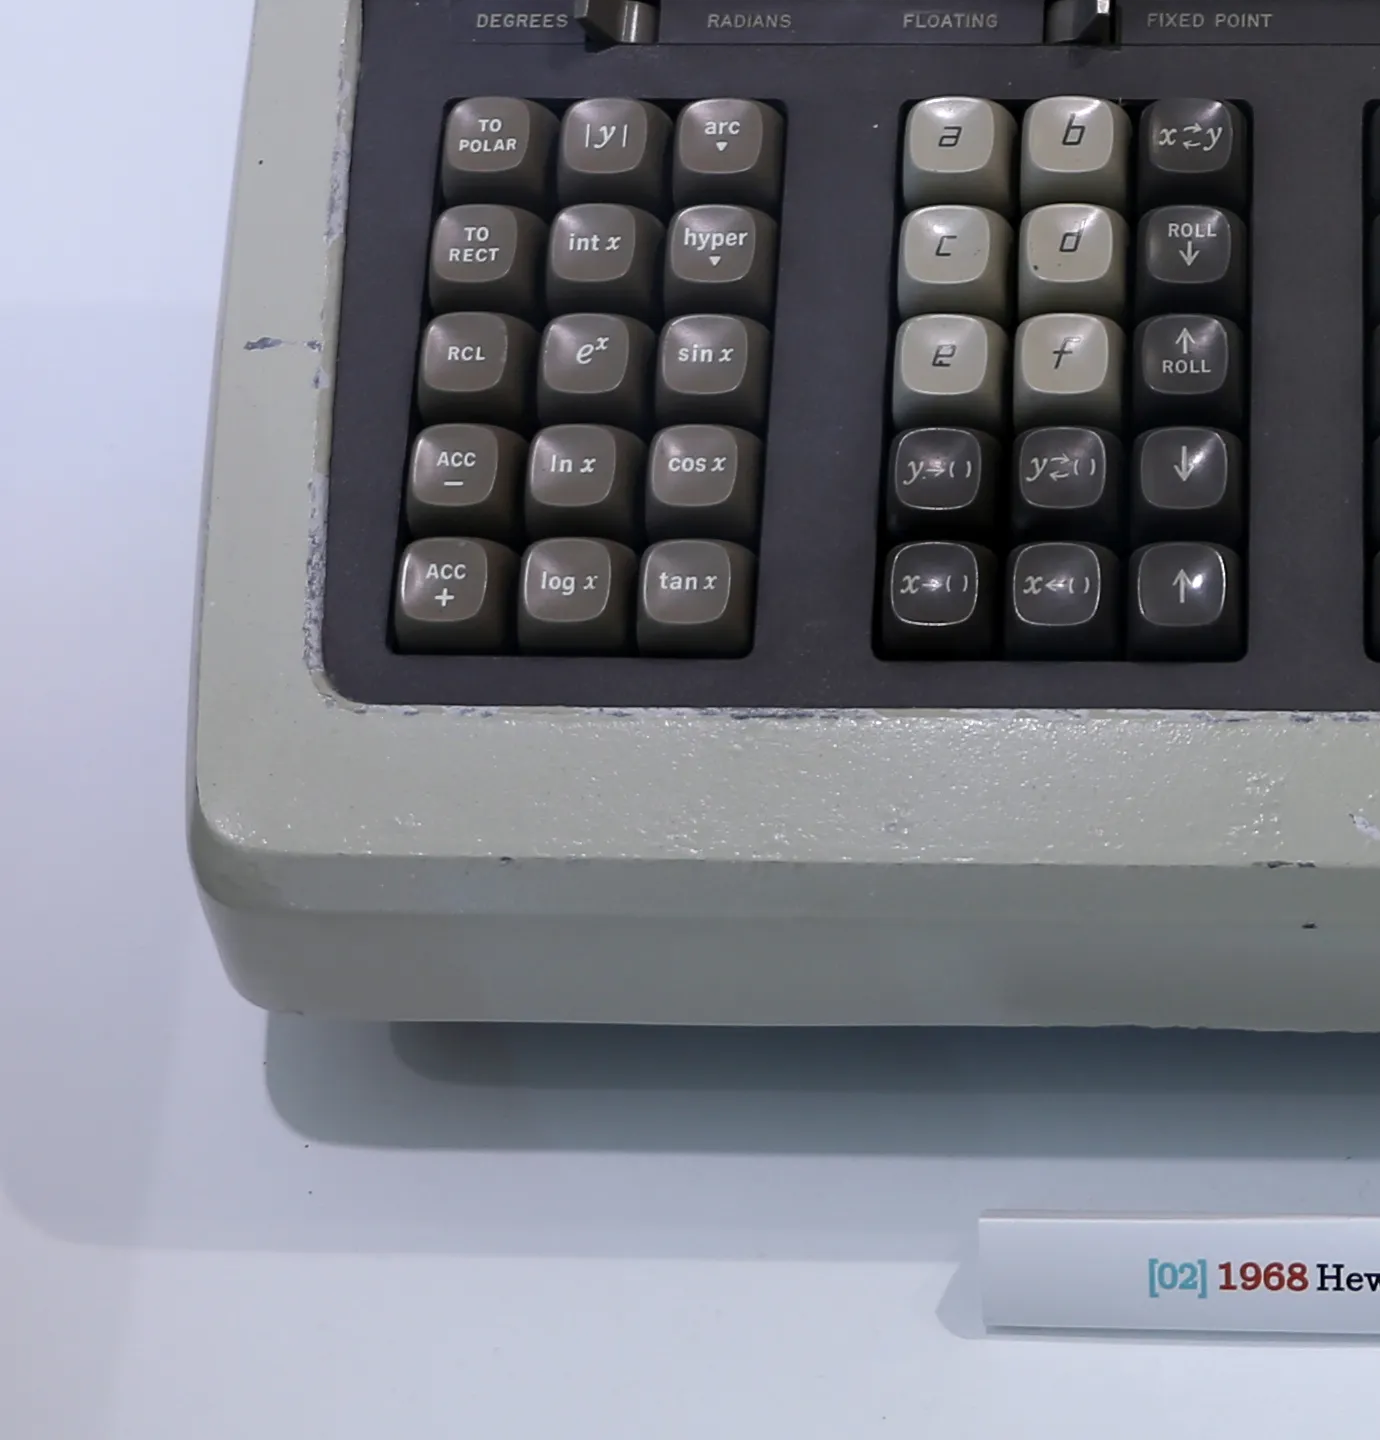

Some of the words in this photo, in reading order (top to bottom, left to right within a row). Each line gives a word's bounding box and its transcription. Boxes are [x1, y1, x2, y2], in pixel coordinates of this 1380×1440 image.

[477, 14, 568, 28] DEGREES
[707, 14, 792, 28] RADIANS
[903, 14, 997, 29] FLOATING
[1147, 13, 1204, 28] FIXED
[1215, 14, 1272, 28] POINT
[478, 118, 502, 133] TO
[705, 120, 740, 135] arc
[1062, 113, 1085, 146] b
[938, 126, 962, 147] a
[458, 138, 517, 152] POLAR
[464, 227, 490, 241] TO
[1168, 223, 1217, 237] ROLL
[569, 234, 601, 252] int
[605, 236, 621, 252] x
[683, 228, 748, 250] hyper
[448, 247, 500, 262] RECT
[447, 346, 486, 361] RCL
[678, 346, 714, 362] sin
[718, 346, 734, 362] x
[931, 344, 957, 367] e
[1052, 336, 1081, 369] f
[1162, 360, 1211, 373] ROLL
[436, 452, 476, 467] ACC
[551, 455, 575, 473] ln
[579, 457, 596, 473] x
[668, 457, 706, 473] cos
[710, 457, 726, 472] x
[425, 564, 466, 580] ACC
[540, 572, 576, 595] log
[581, 574, 598, 590] x
[660, 572, 699, 590] tan
[702, 574, 718, 590] x
[1149, 1258, 1207, 1299] [02]
[1218, 1261, 1309, 1292] 1968
